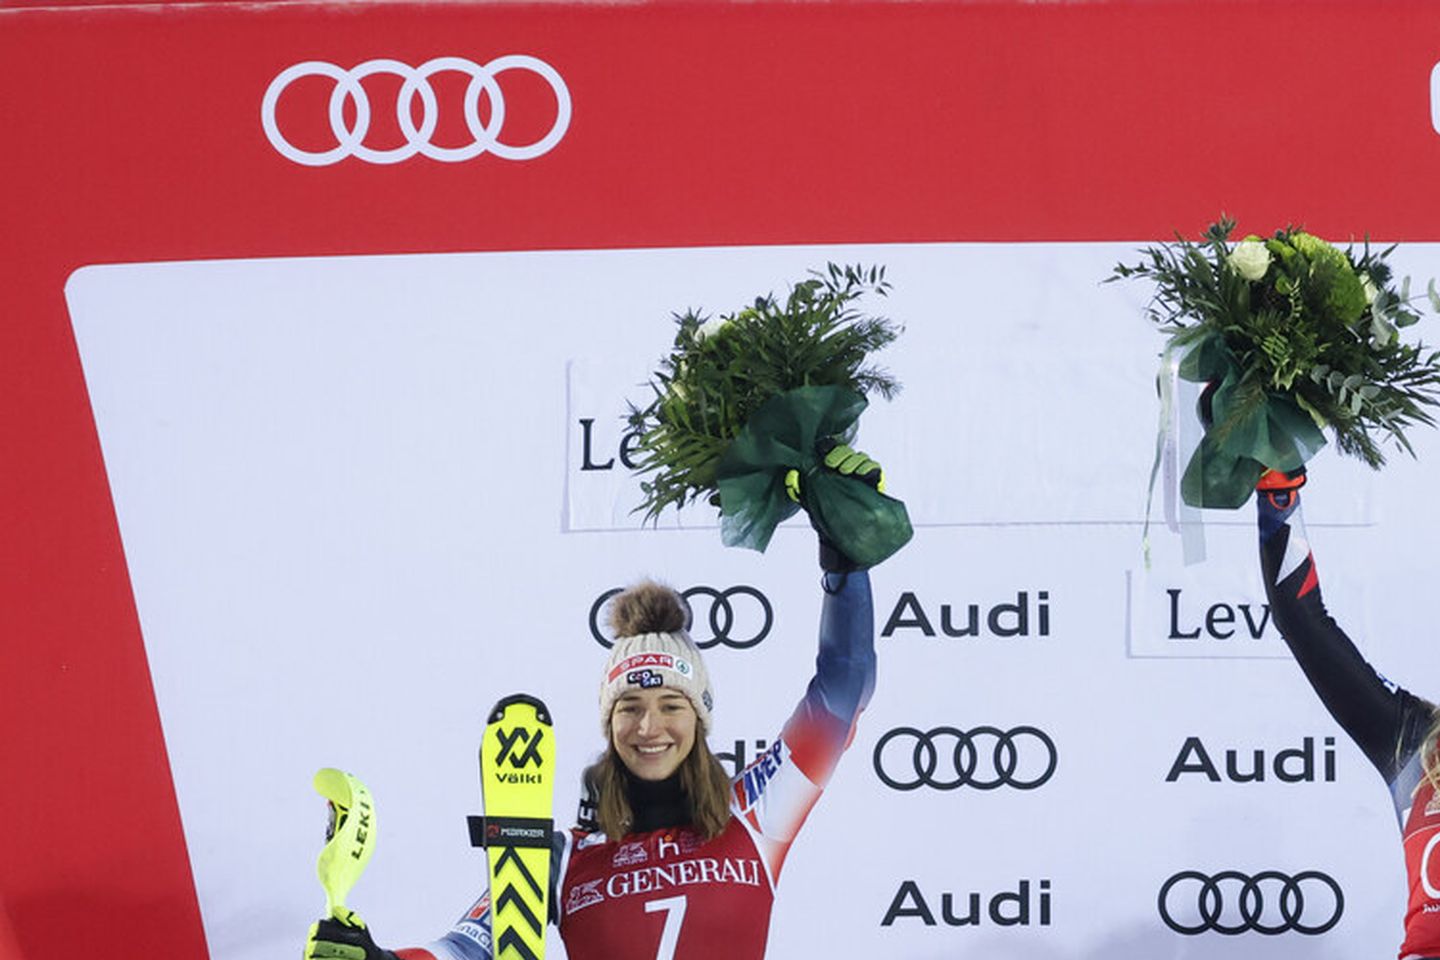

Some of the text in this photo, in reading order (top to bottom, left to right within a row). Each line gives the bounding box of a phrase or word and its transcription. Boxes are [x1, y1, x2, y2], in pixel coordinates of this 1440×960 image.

[881, 591, 1050, 637] Audi
[1166, 589, 1286, 640] Lev
[620, 655, 673, 670] SPAR
[495, 773, 543, 784] Völkl
[1166, 737, 1337, 783] Audi
[351, 801, 370, 860] LEKI
[606, 857, 760, 898] GENERALI
[881, 879, 1050, 926] Audi
